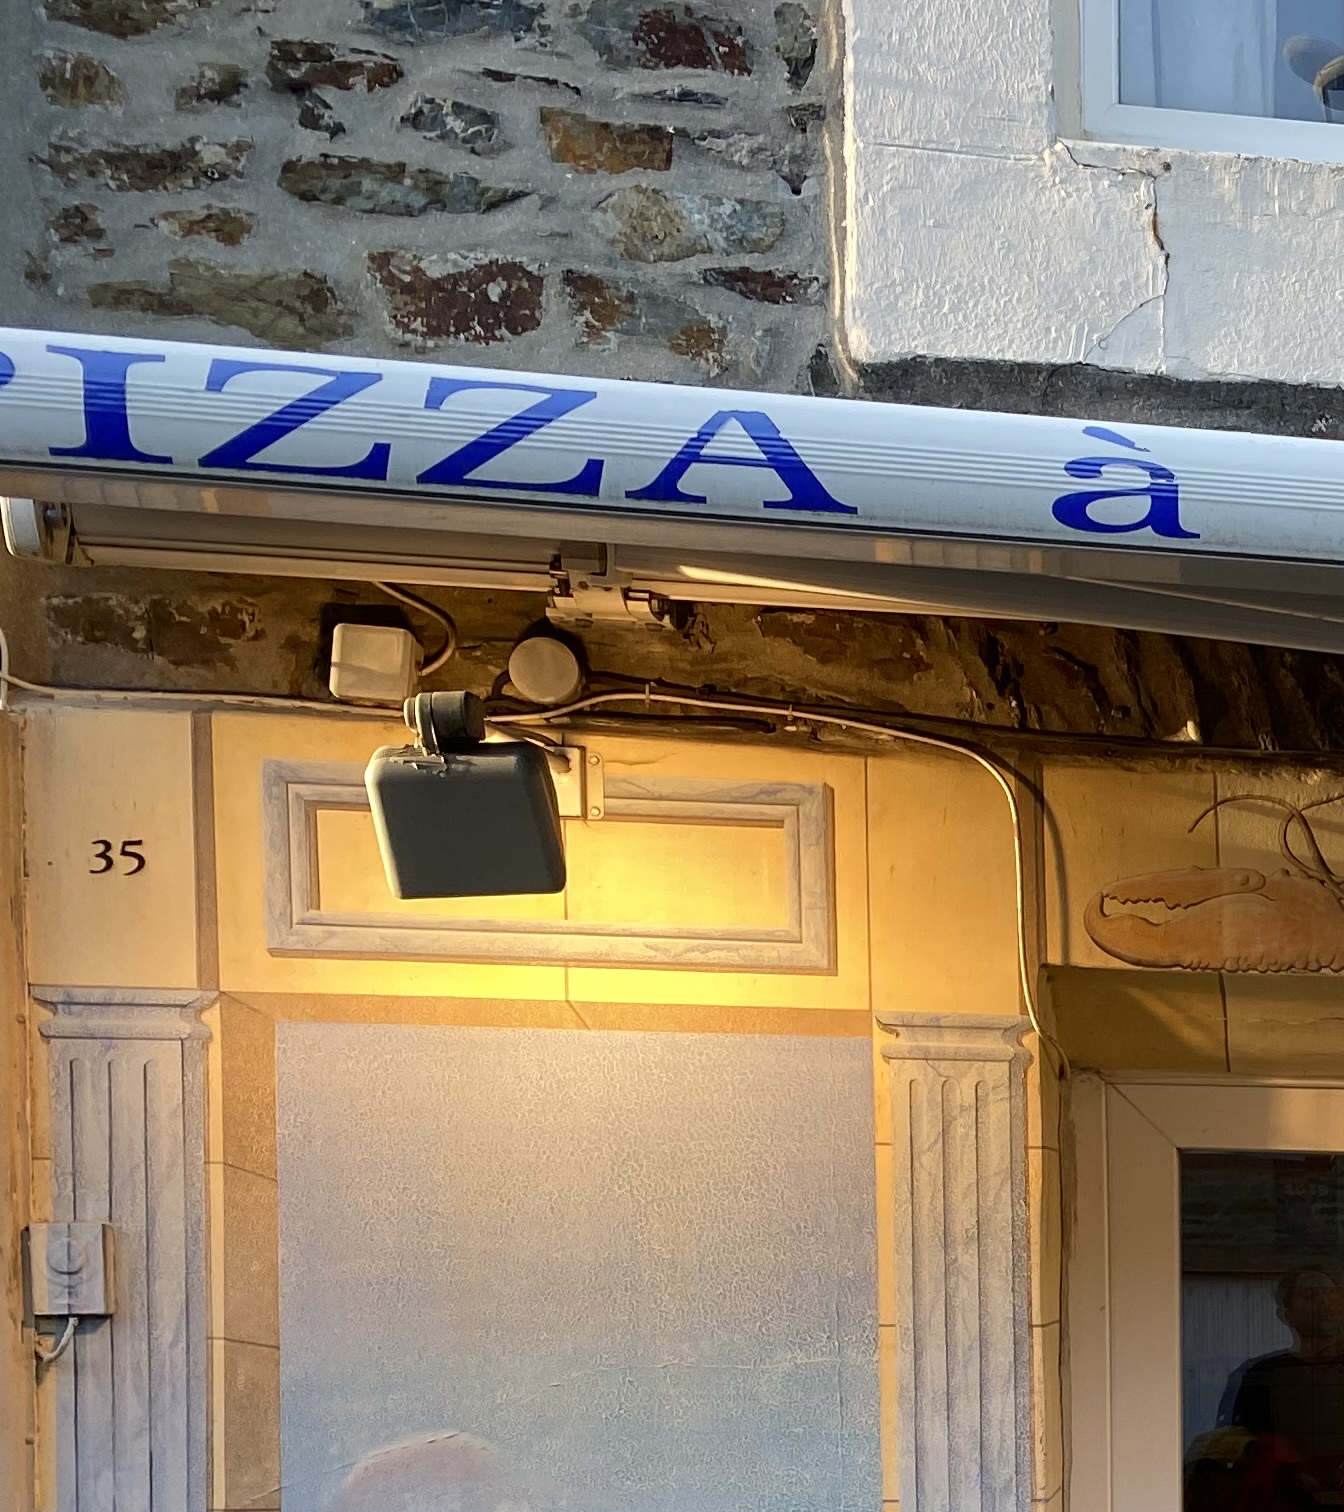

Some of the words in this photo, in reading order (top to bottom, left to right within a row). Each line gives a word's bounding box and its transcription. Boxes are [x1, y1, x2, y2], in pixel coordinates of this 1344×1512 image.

[0, 344, 858, 514] IZZA
[1051, 425, 1201, 539] à
[89, 839, 146, 876] 35
